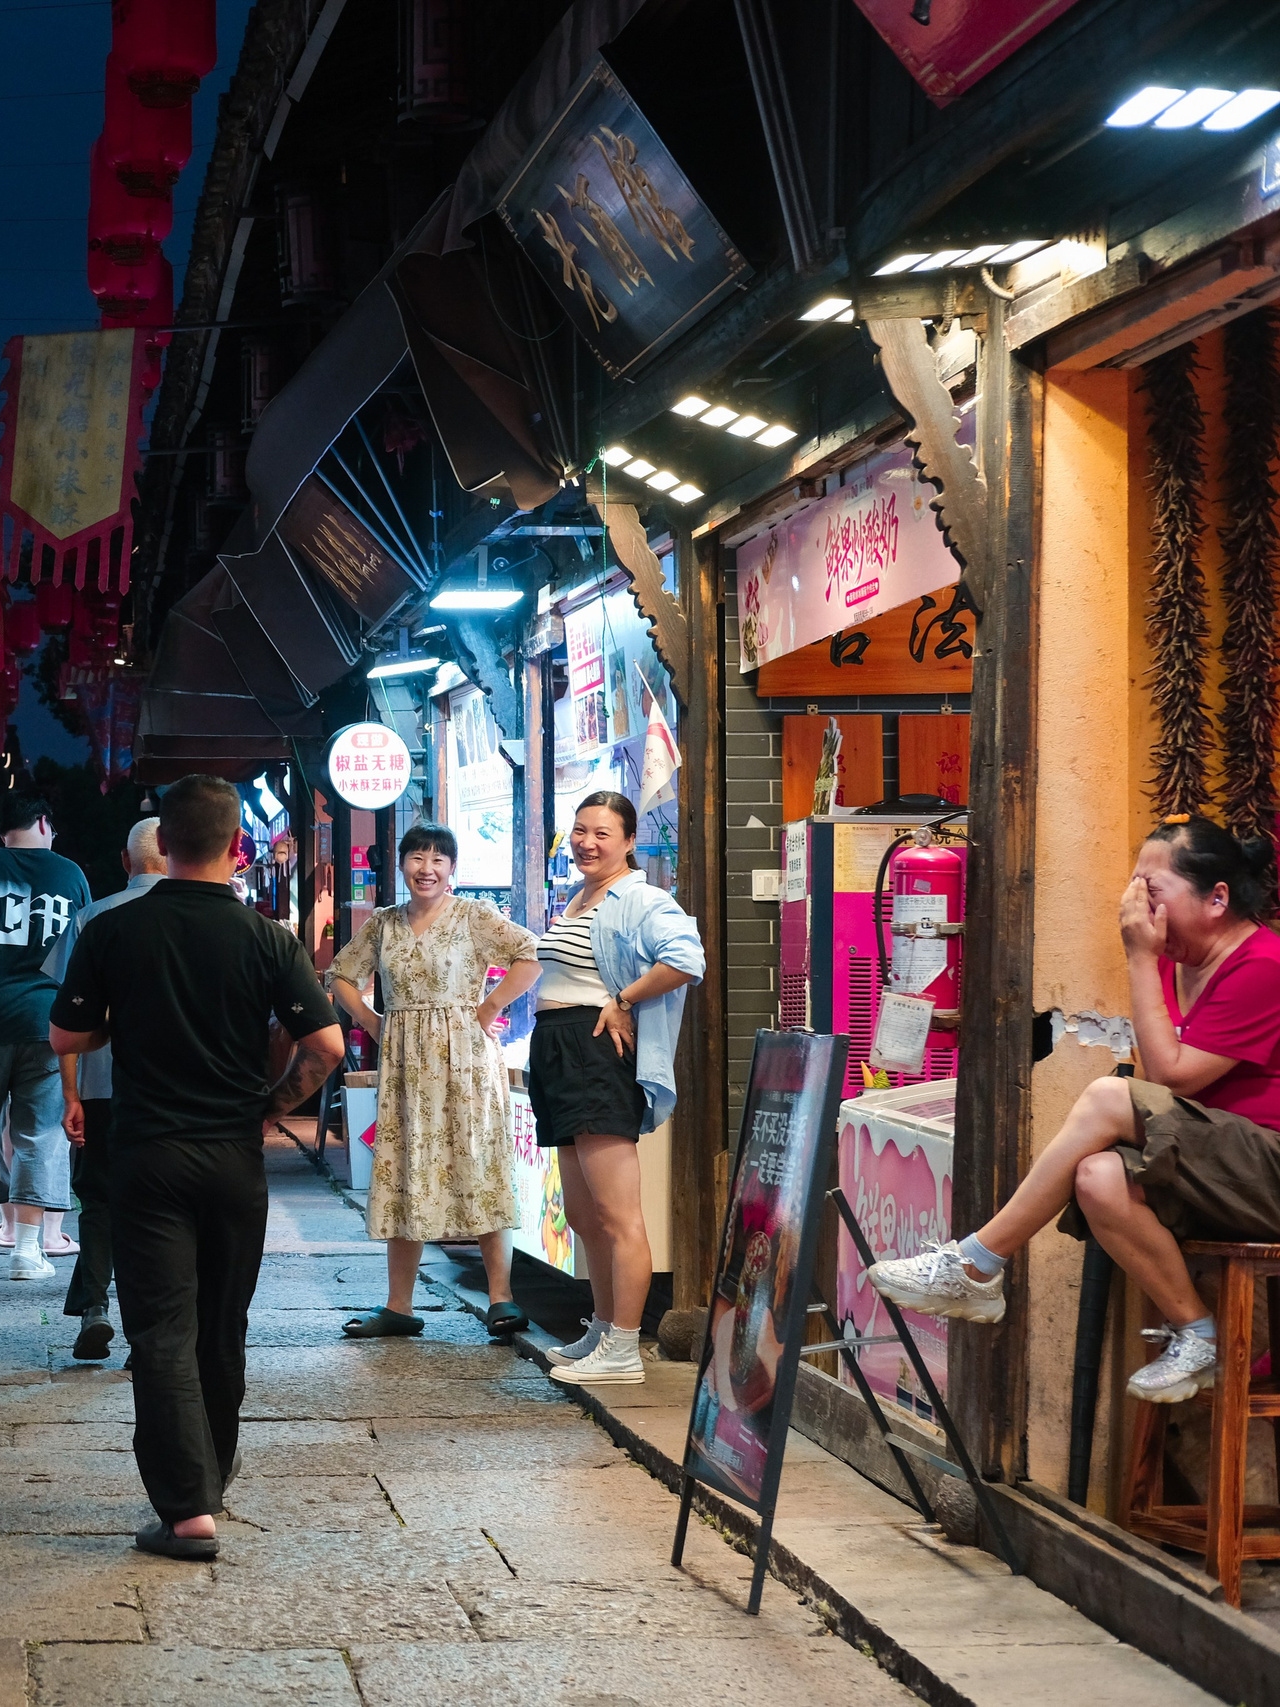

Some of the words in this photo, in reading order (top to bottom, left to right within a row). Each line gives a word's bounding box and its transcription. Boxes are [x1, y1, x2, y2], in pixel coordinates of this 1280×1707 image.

[825, 492, 899, 604] 鲜果炒酸奶
[336, 754, 405, 772] 椒盐无糖
[338, 778, 403, 792] 小米酥芝麻片
[752, 1110, 809, 1148] 买不买没关系
[750, 1149, 795, 1186] 一定要尝尝
